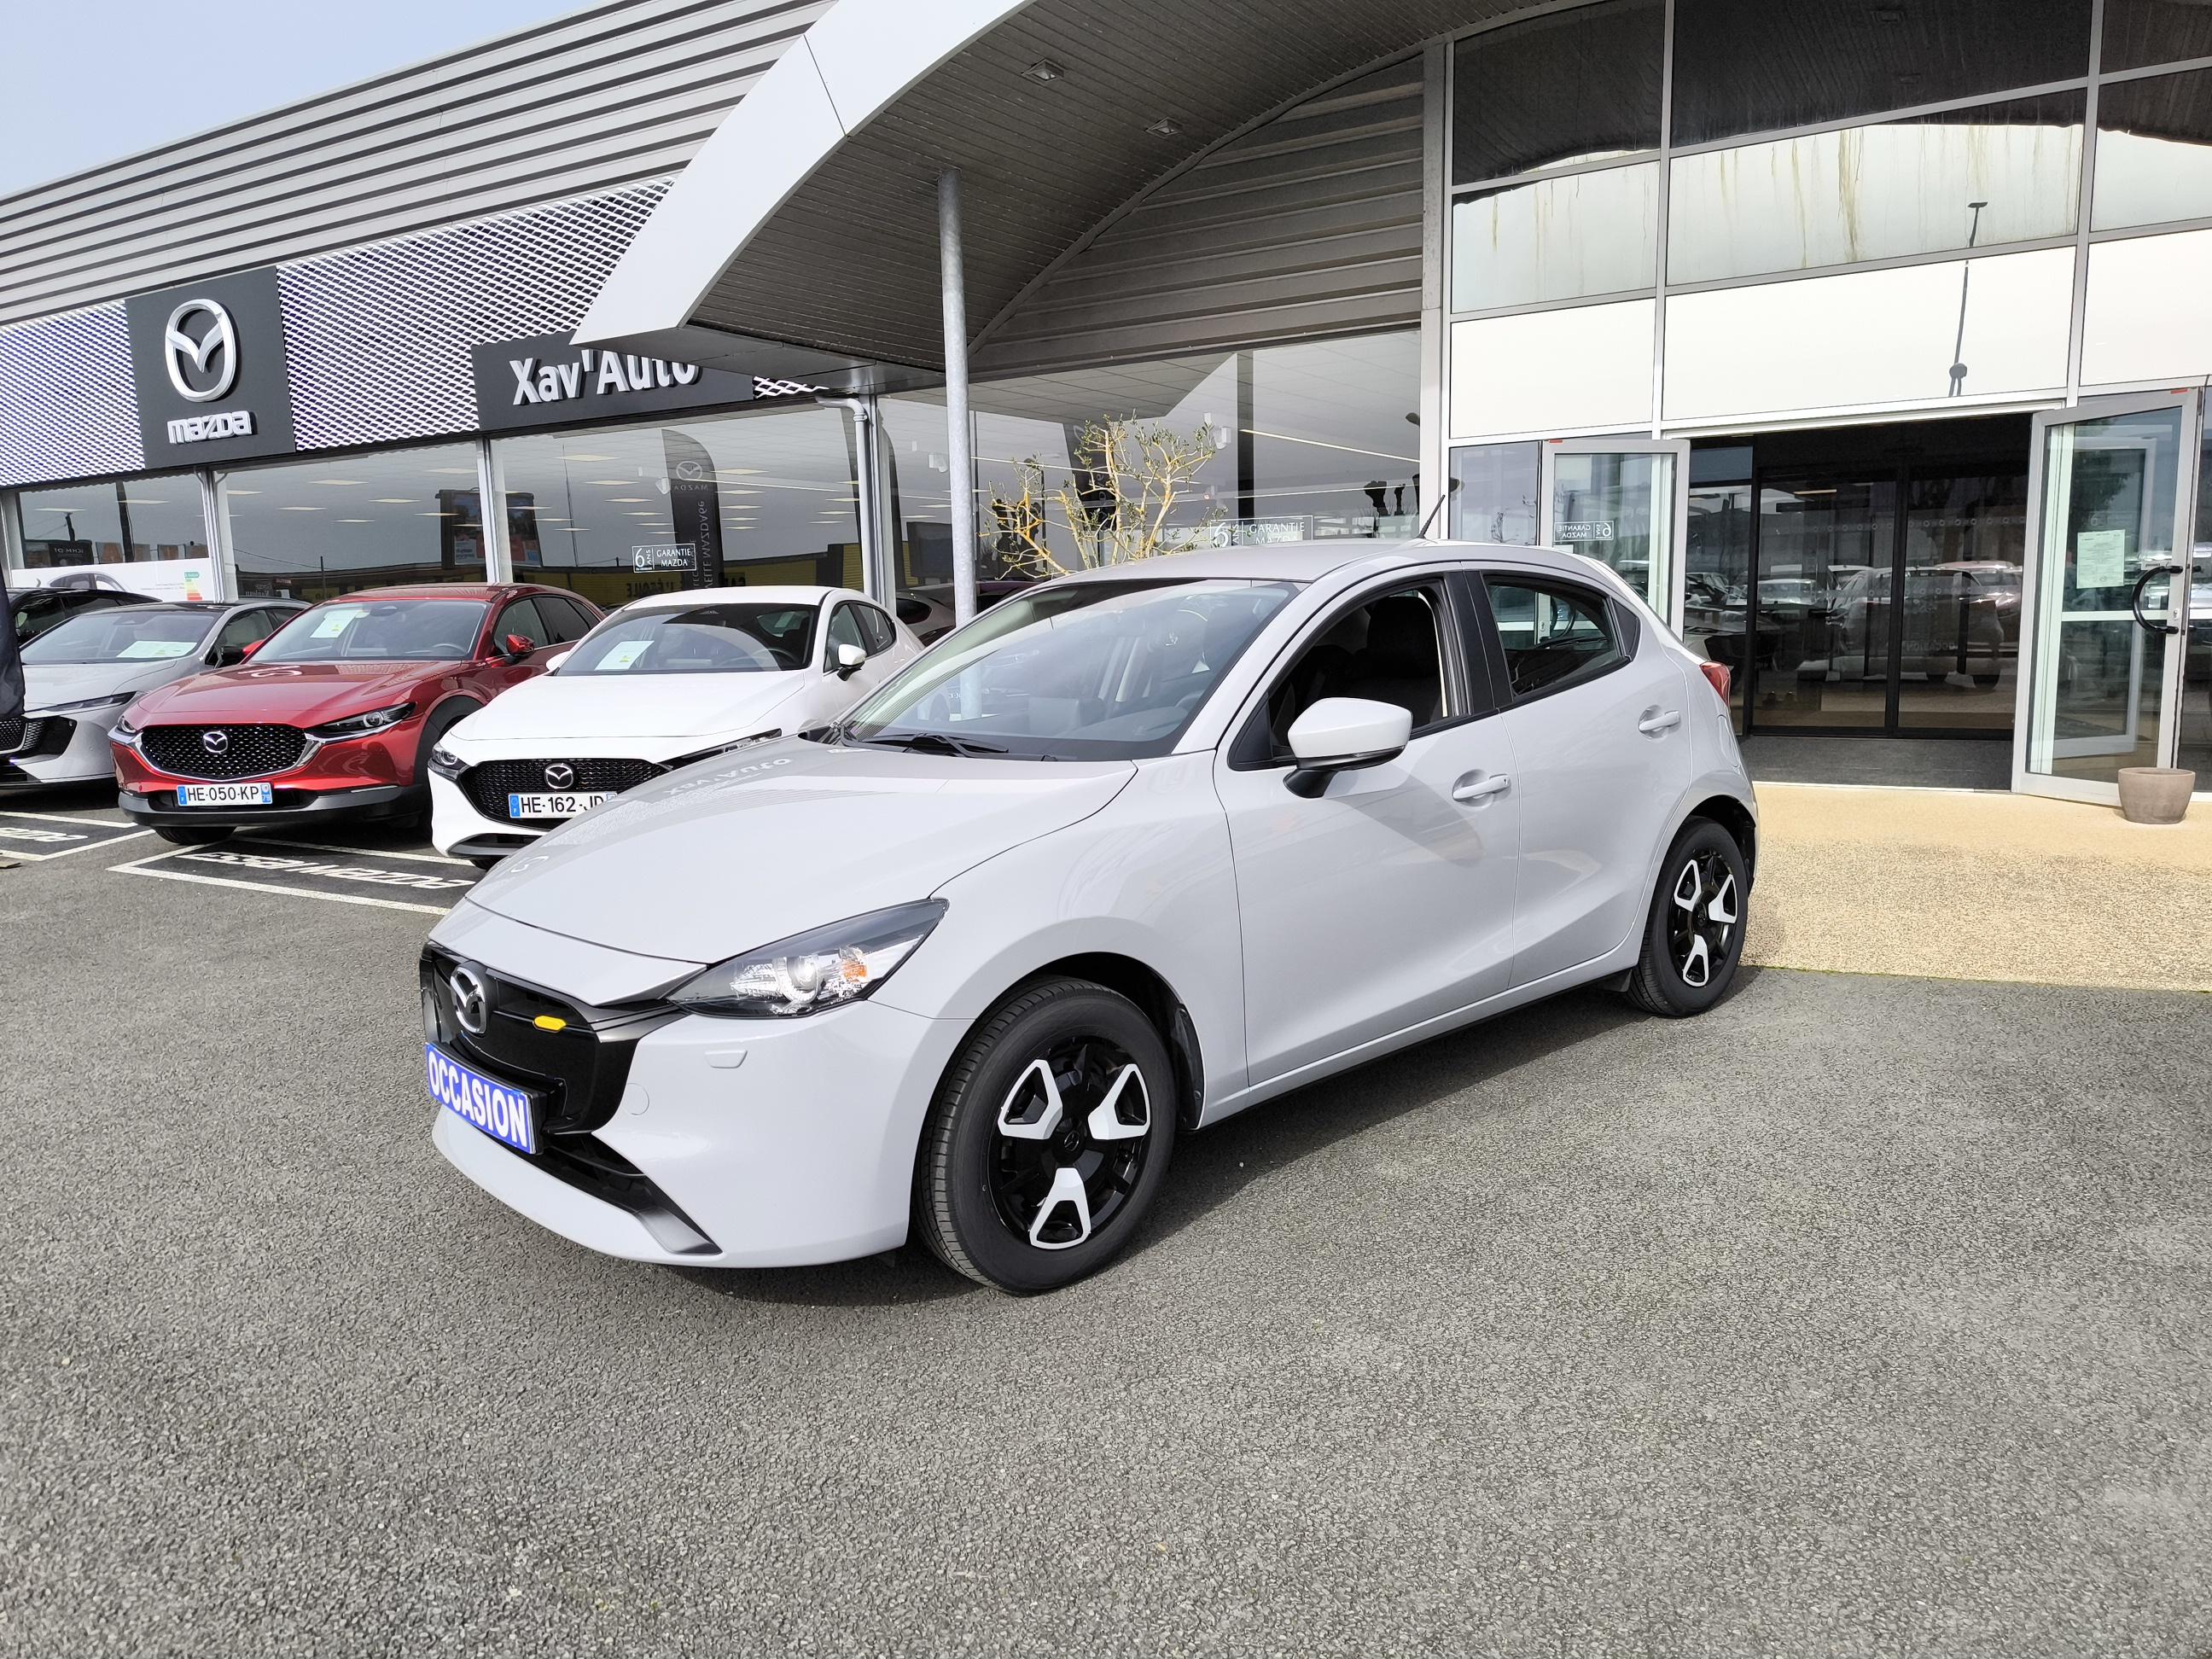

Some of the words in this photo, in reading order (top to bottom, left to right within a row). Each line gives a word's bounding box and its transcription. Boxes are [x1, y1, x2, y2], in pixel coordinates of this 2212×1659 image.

[509, 348, 699, 405] Xav'Auto
[1249, 521, 1305, 533] GARANTIE
[635, 548, 645, 568] 6
[656, 548, 691, 557] GARANTIE
[661, 558, 688, 567] MAZDA
[428, 1051, 527, 1148] OCCASION
